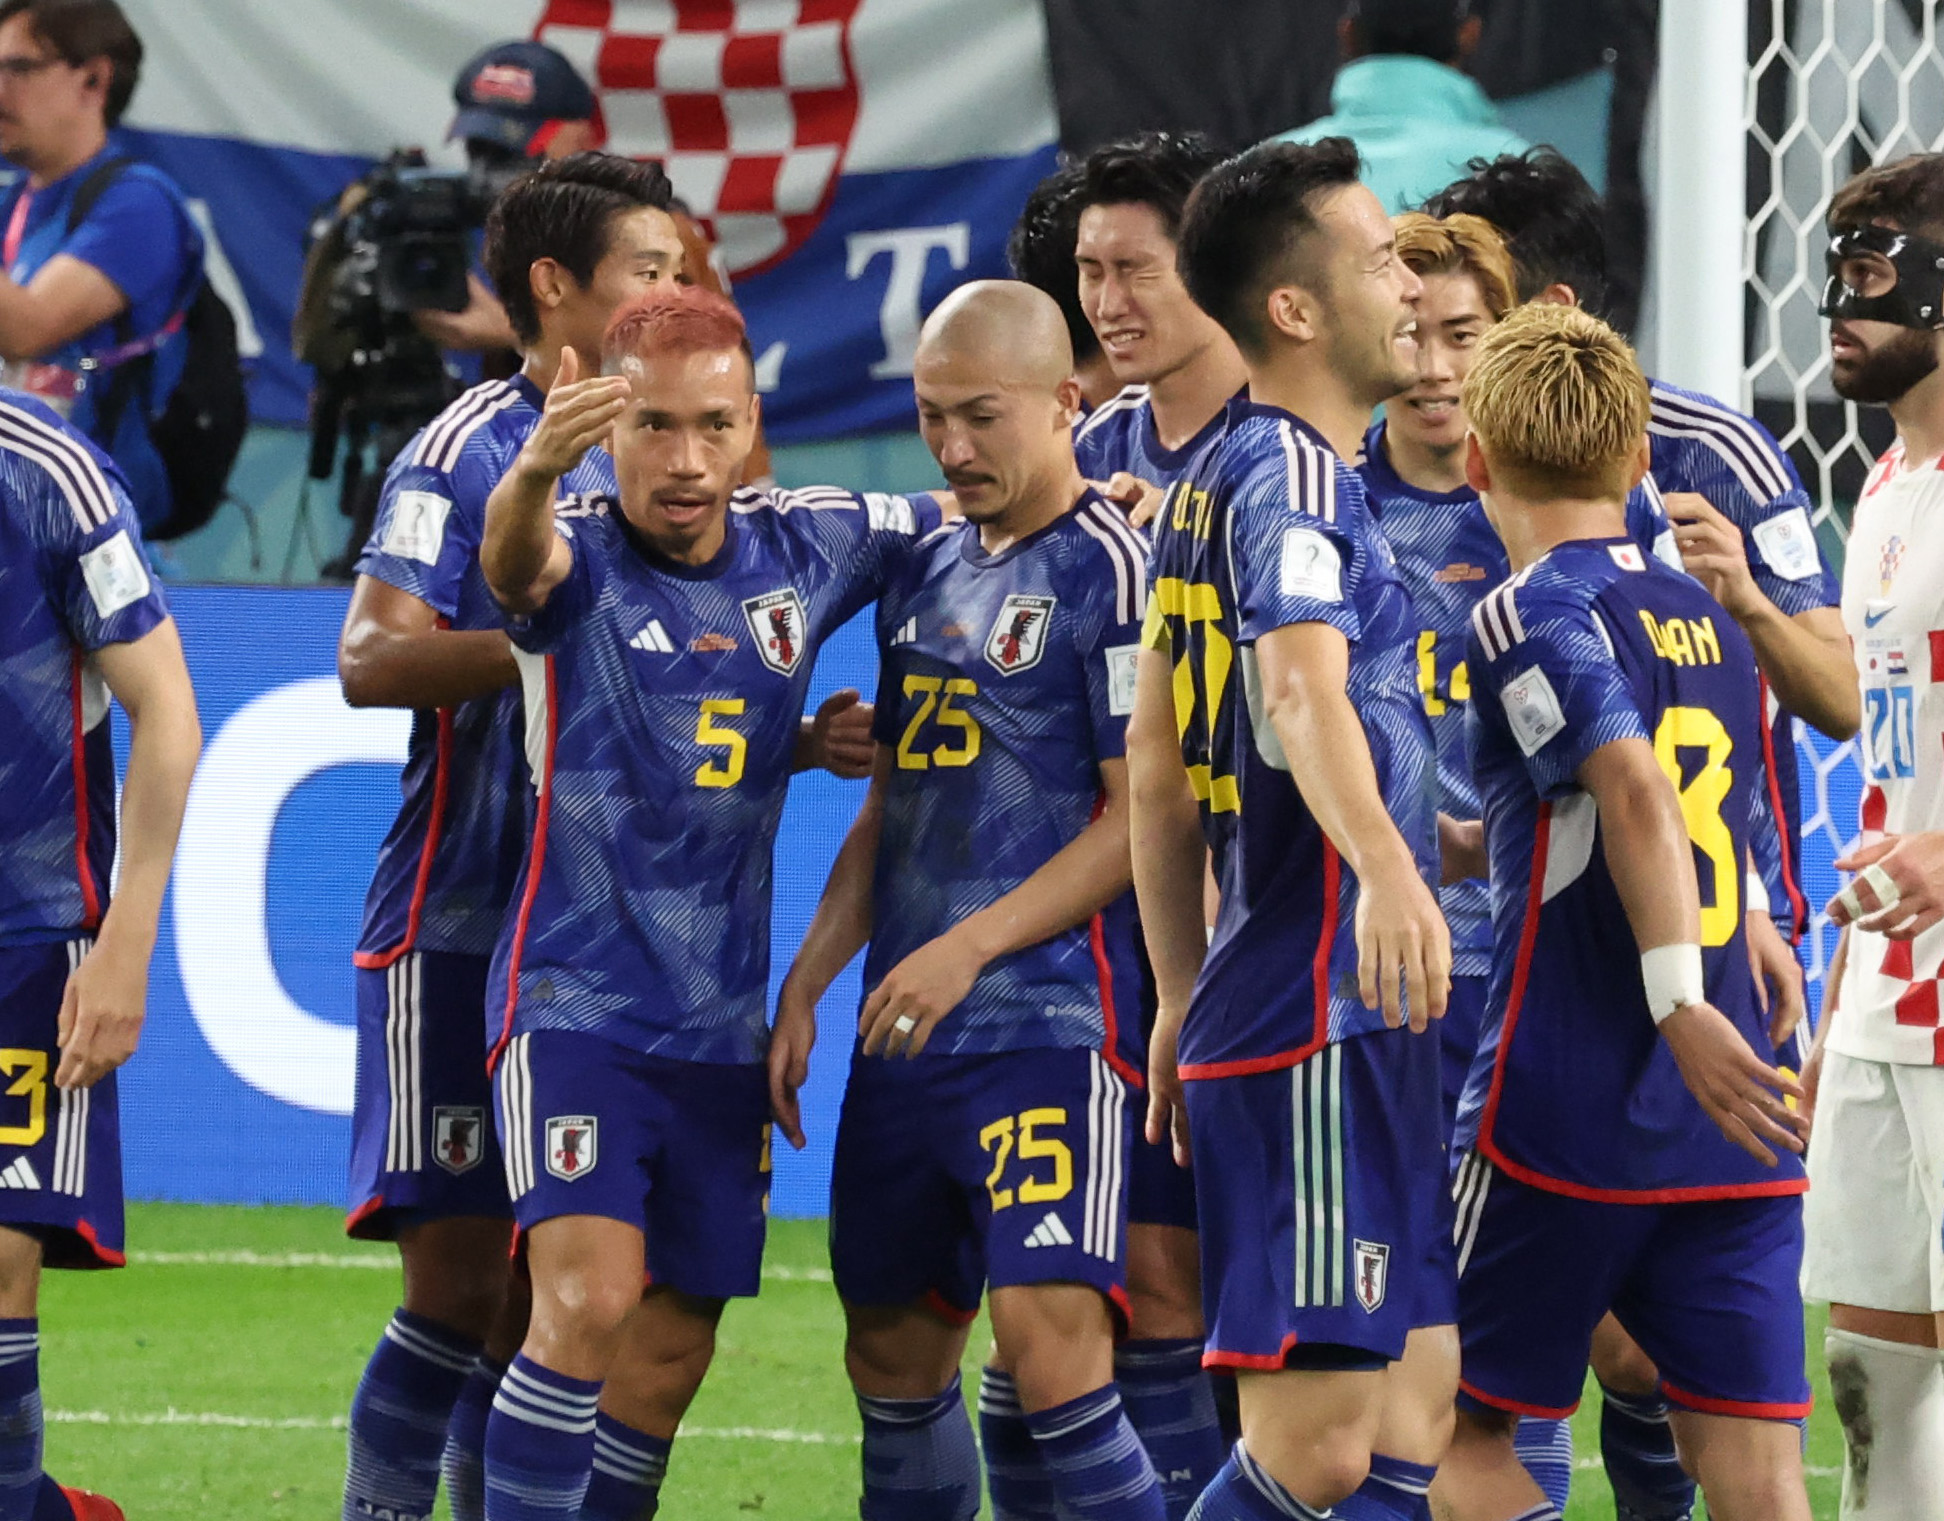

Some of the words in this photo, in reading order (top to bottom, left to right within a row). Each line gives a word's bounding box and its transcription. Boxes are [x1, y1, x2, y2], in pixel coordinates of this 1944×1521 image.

[695, 698, 748, 789] 5
[897, 674, 982, 770] 25
[1865, 685, 1915, 779] 20
[1653, 706, 1739, 947] 8
[980, 1107, 1073, 1214] 25
